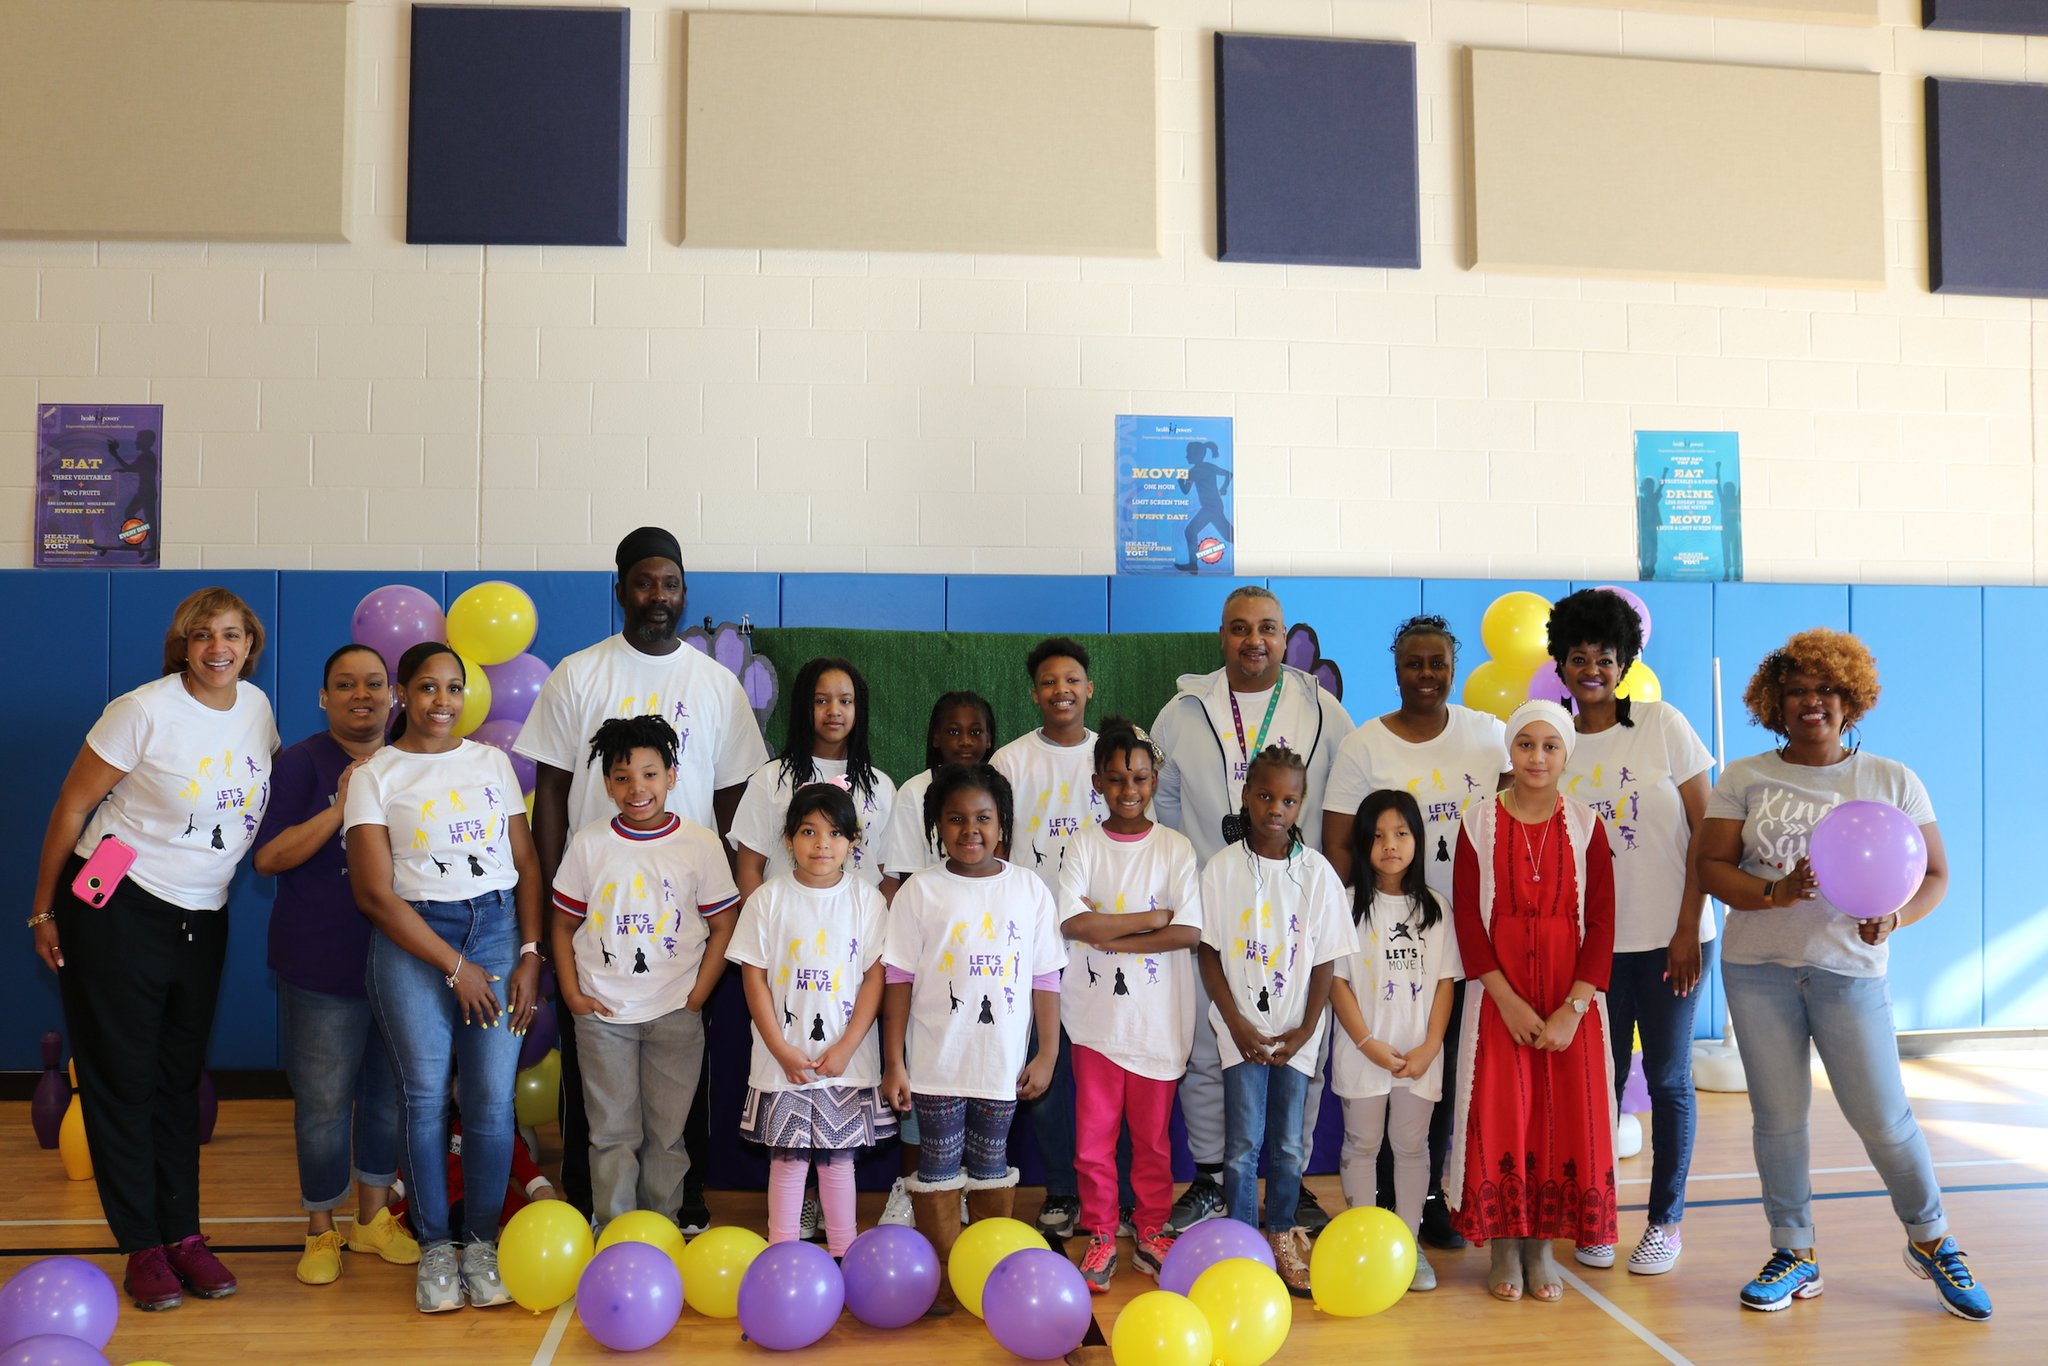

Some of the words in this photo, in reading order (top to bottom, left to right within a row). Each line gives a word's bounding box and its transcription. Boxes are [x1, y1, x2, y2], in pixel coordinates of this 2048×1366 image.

[61, 458, 102, 469] EAT
[1132, 468, 1189, 479] MOVE
[1674, 469, 1704, 478] EAT
[1666, 490, 1714, 499] DRINK
[1670, 515, 1711, 524] MOVE
[119, 528, 136, 540] EVERY
[216, 788, 243, 800] LET'S
[1429, 802, 1457, 814] LET'S
[1589, 800, 1612, 811] ET'S
[448, 820, 482, 834] LET'S
[1049, 818, 1077, 827] LET'S
[616, 914, 650, 925] LET'S
[1246, 940, 1267, 954] LETS
[1386, 948, 1418, 960] LET'S
[970, 955, 1002, 965] LET'S
[1388, 960, 1416, 971] MOVE
[797, 968, 829, 980] LET'S
